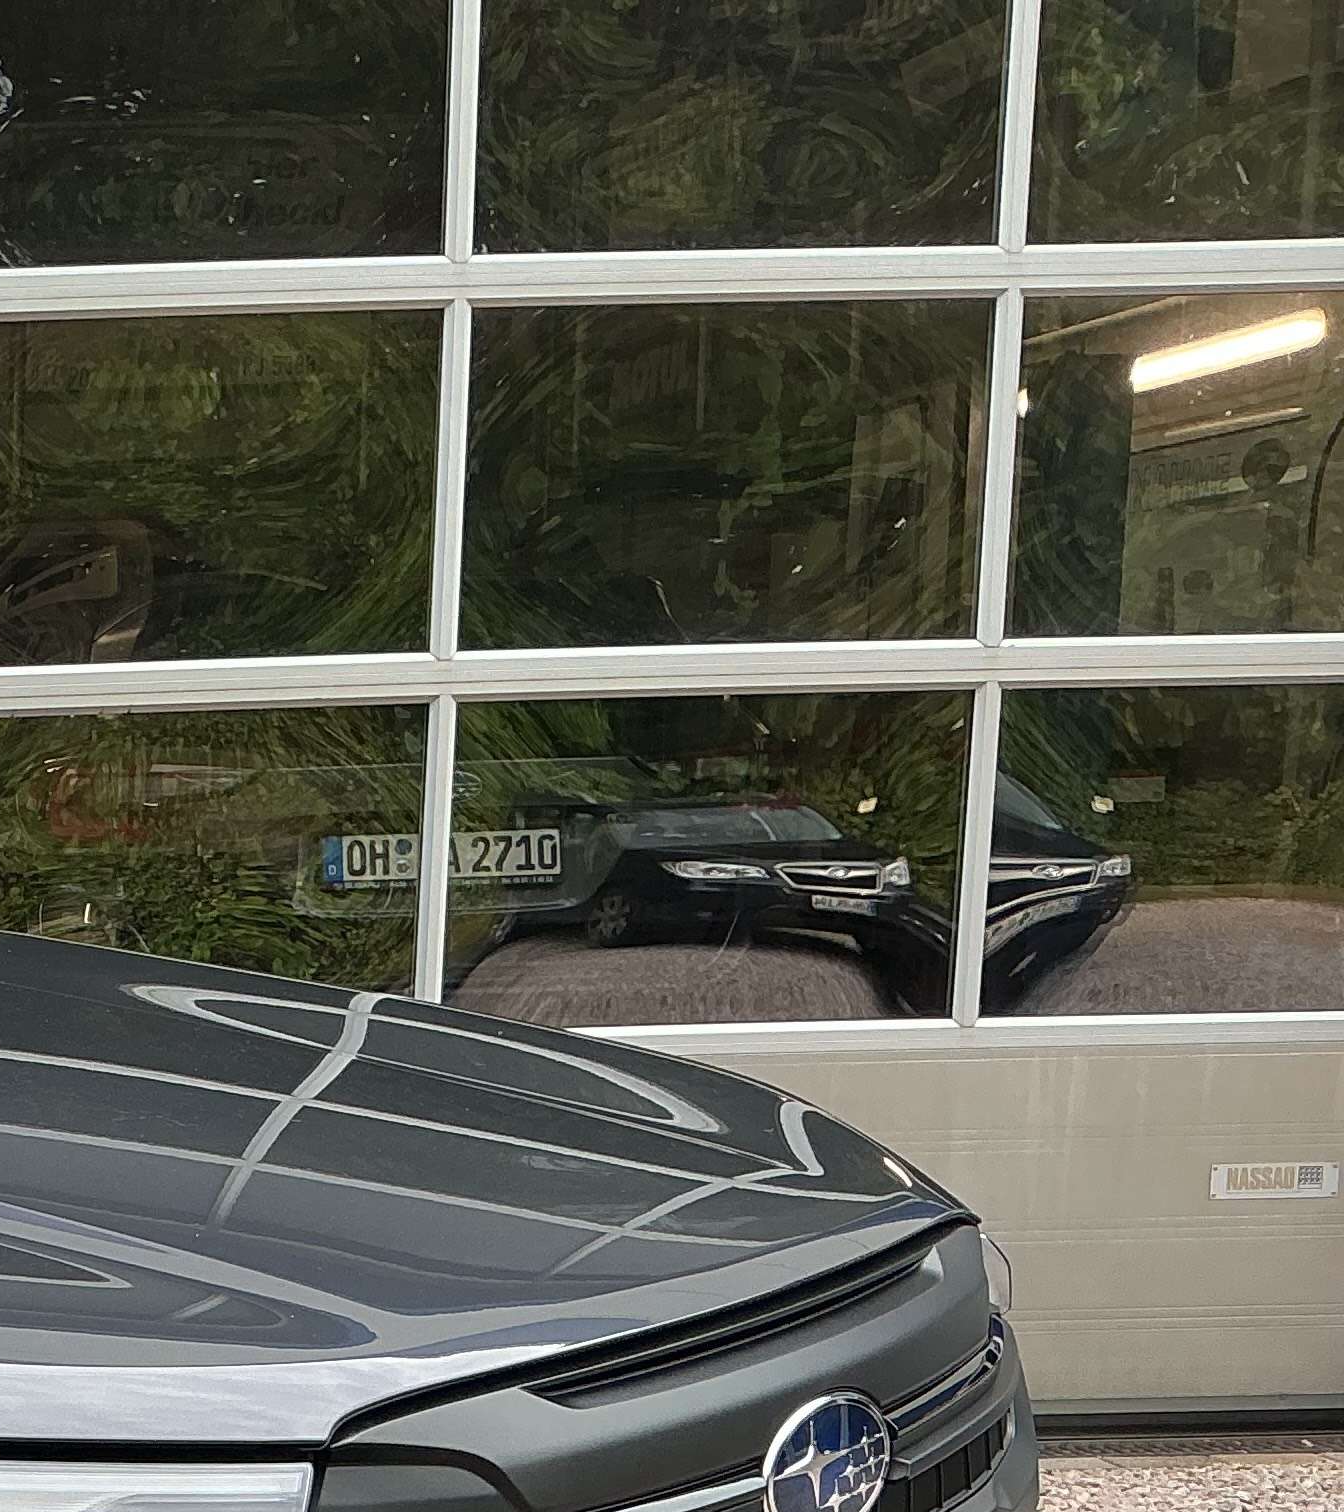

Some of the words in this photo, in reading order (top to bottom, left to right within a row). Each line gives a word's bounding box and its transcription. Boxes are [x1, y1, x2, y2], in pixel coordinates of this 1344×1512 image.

[346, 838, 391, 877] OH
[471, 833, 557, 872] 2710
[1227, 1166, 1296, 1191] NASSAU
